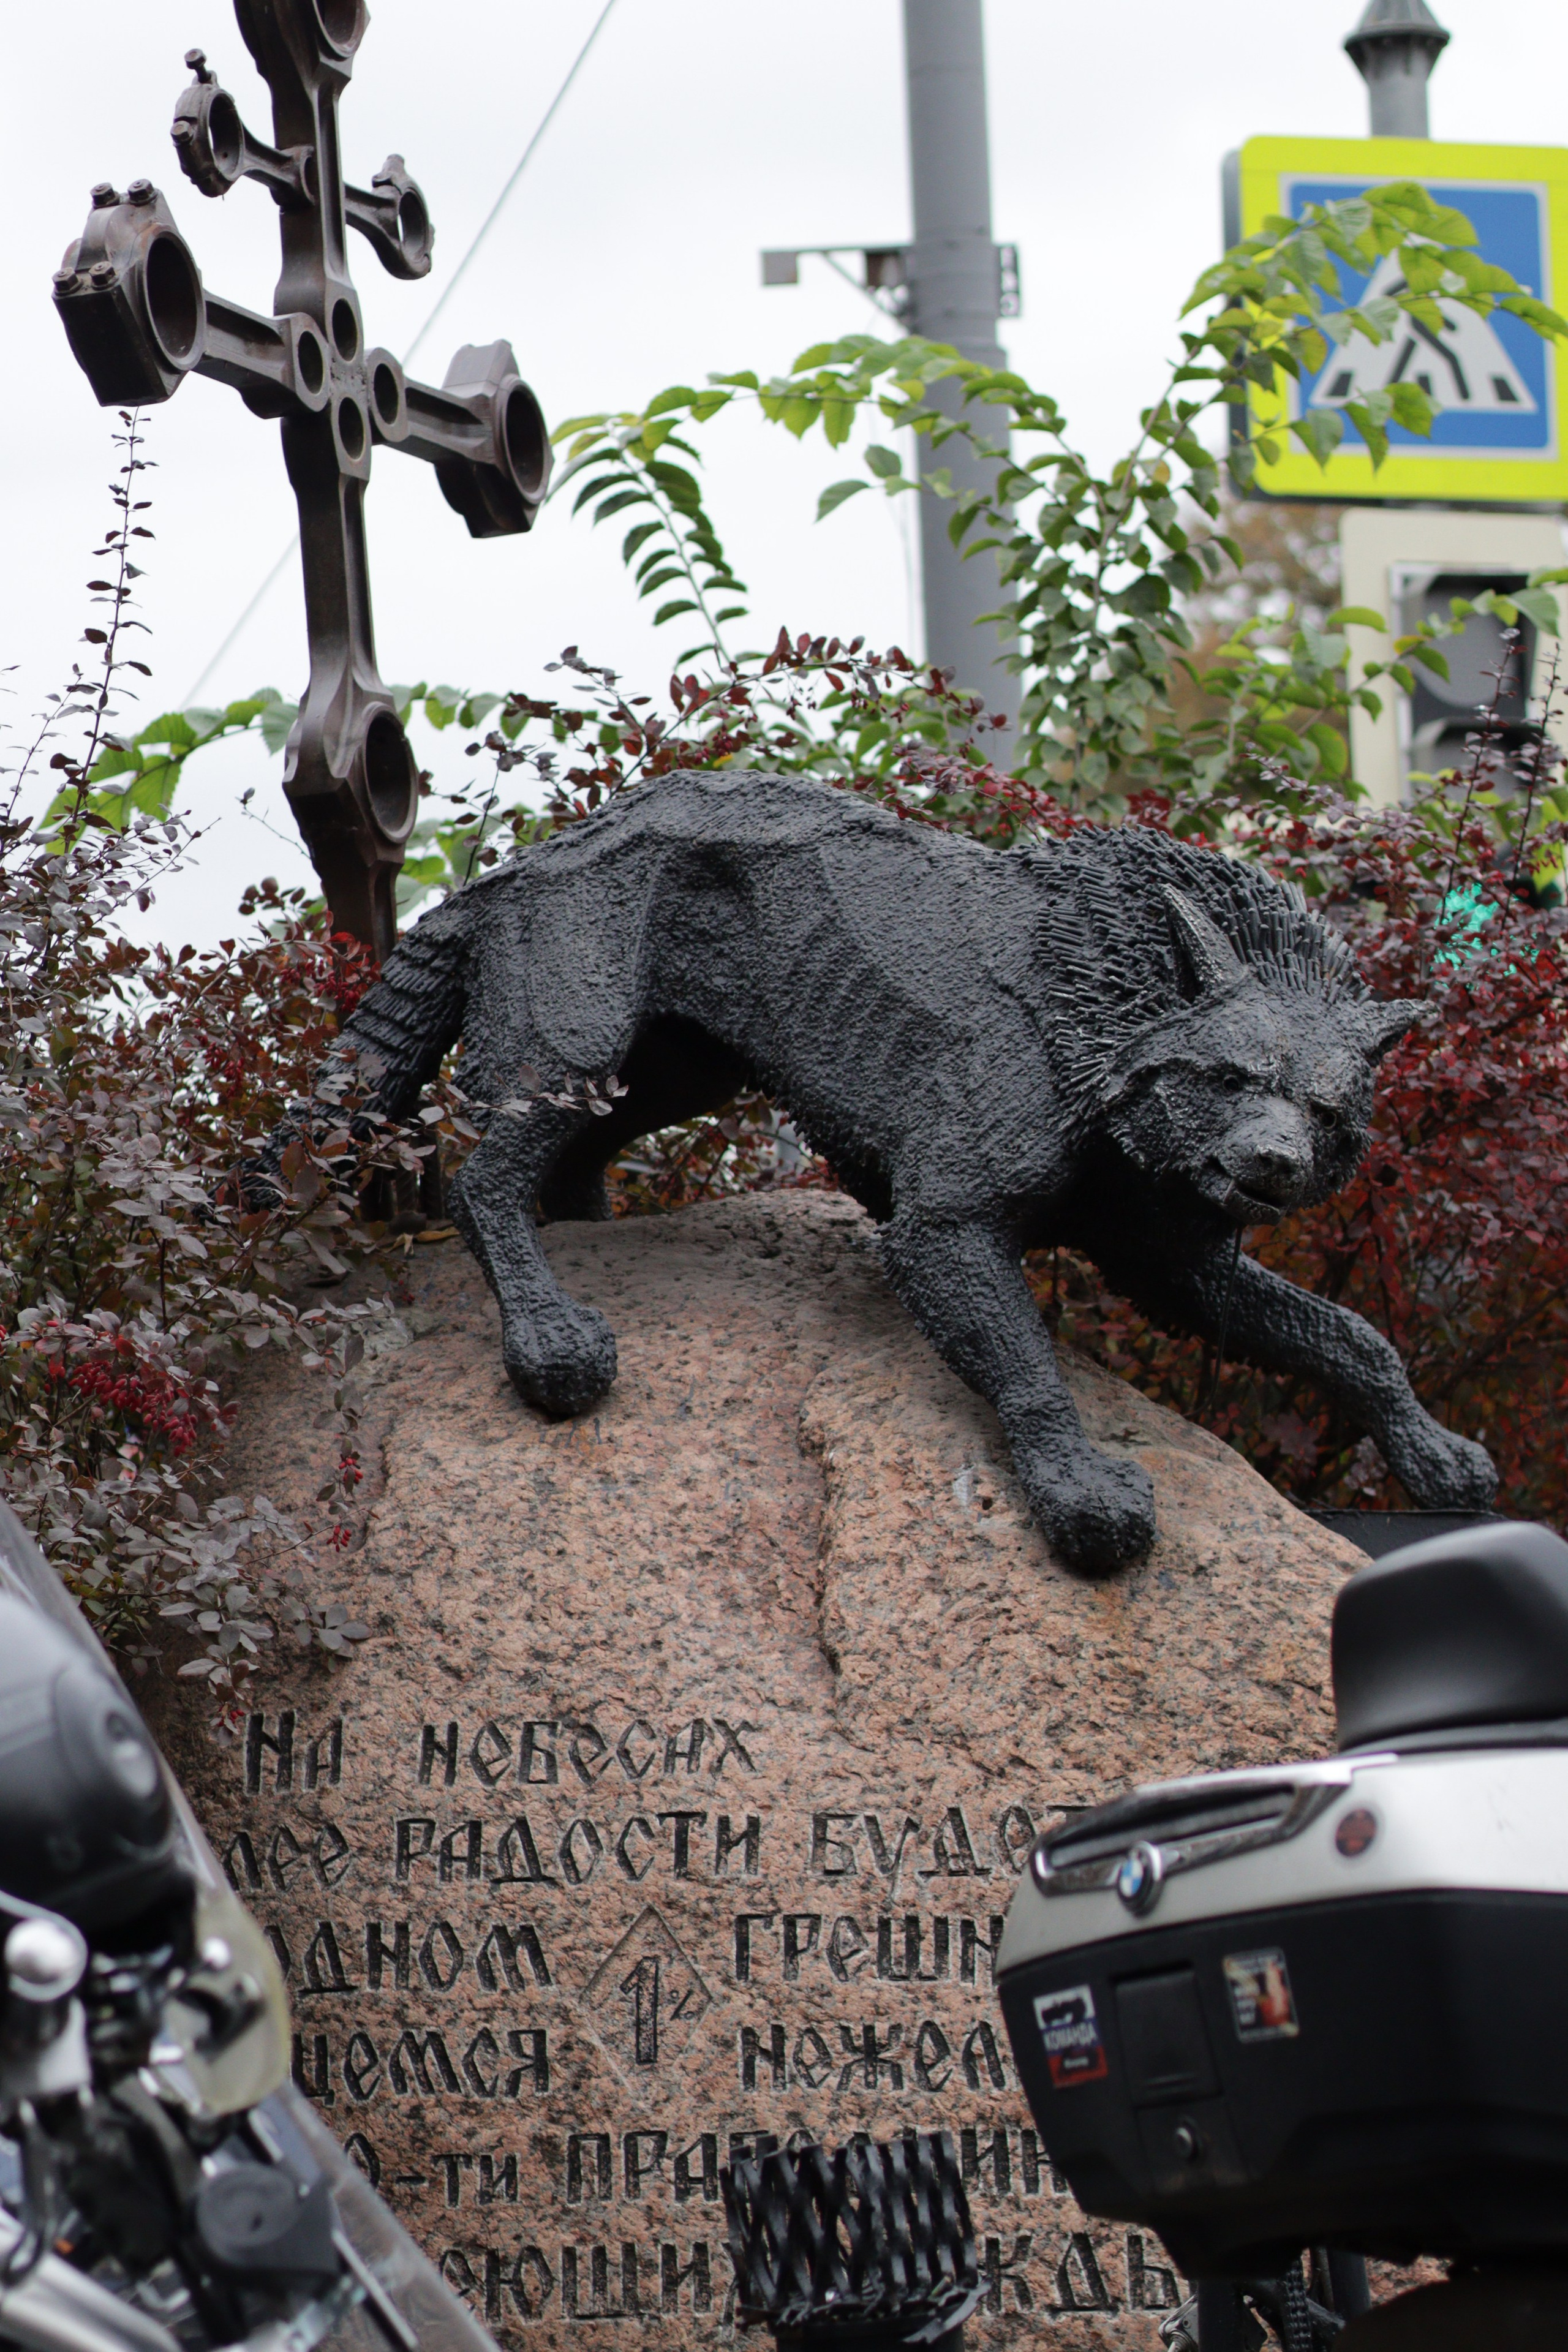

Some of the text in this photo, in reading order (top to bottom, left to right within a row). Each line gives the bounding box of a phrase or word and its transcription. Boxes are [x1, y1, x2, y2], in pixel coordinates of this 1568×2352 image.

[246, 1713, 343, 1795] НА
[396, 1811, 760, 1886] РАДОСТИ
[741, 2020, 1006, 2092] НЕЖЕЛ
